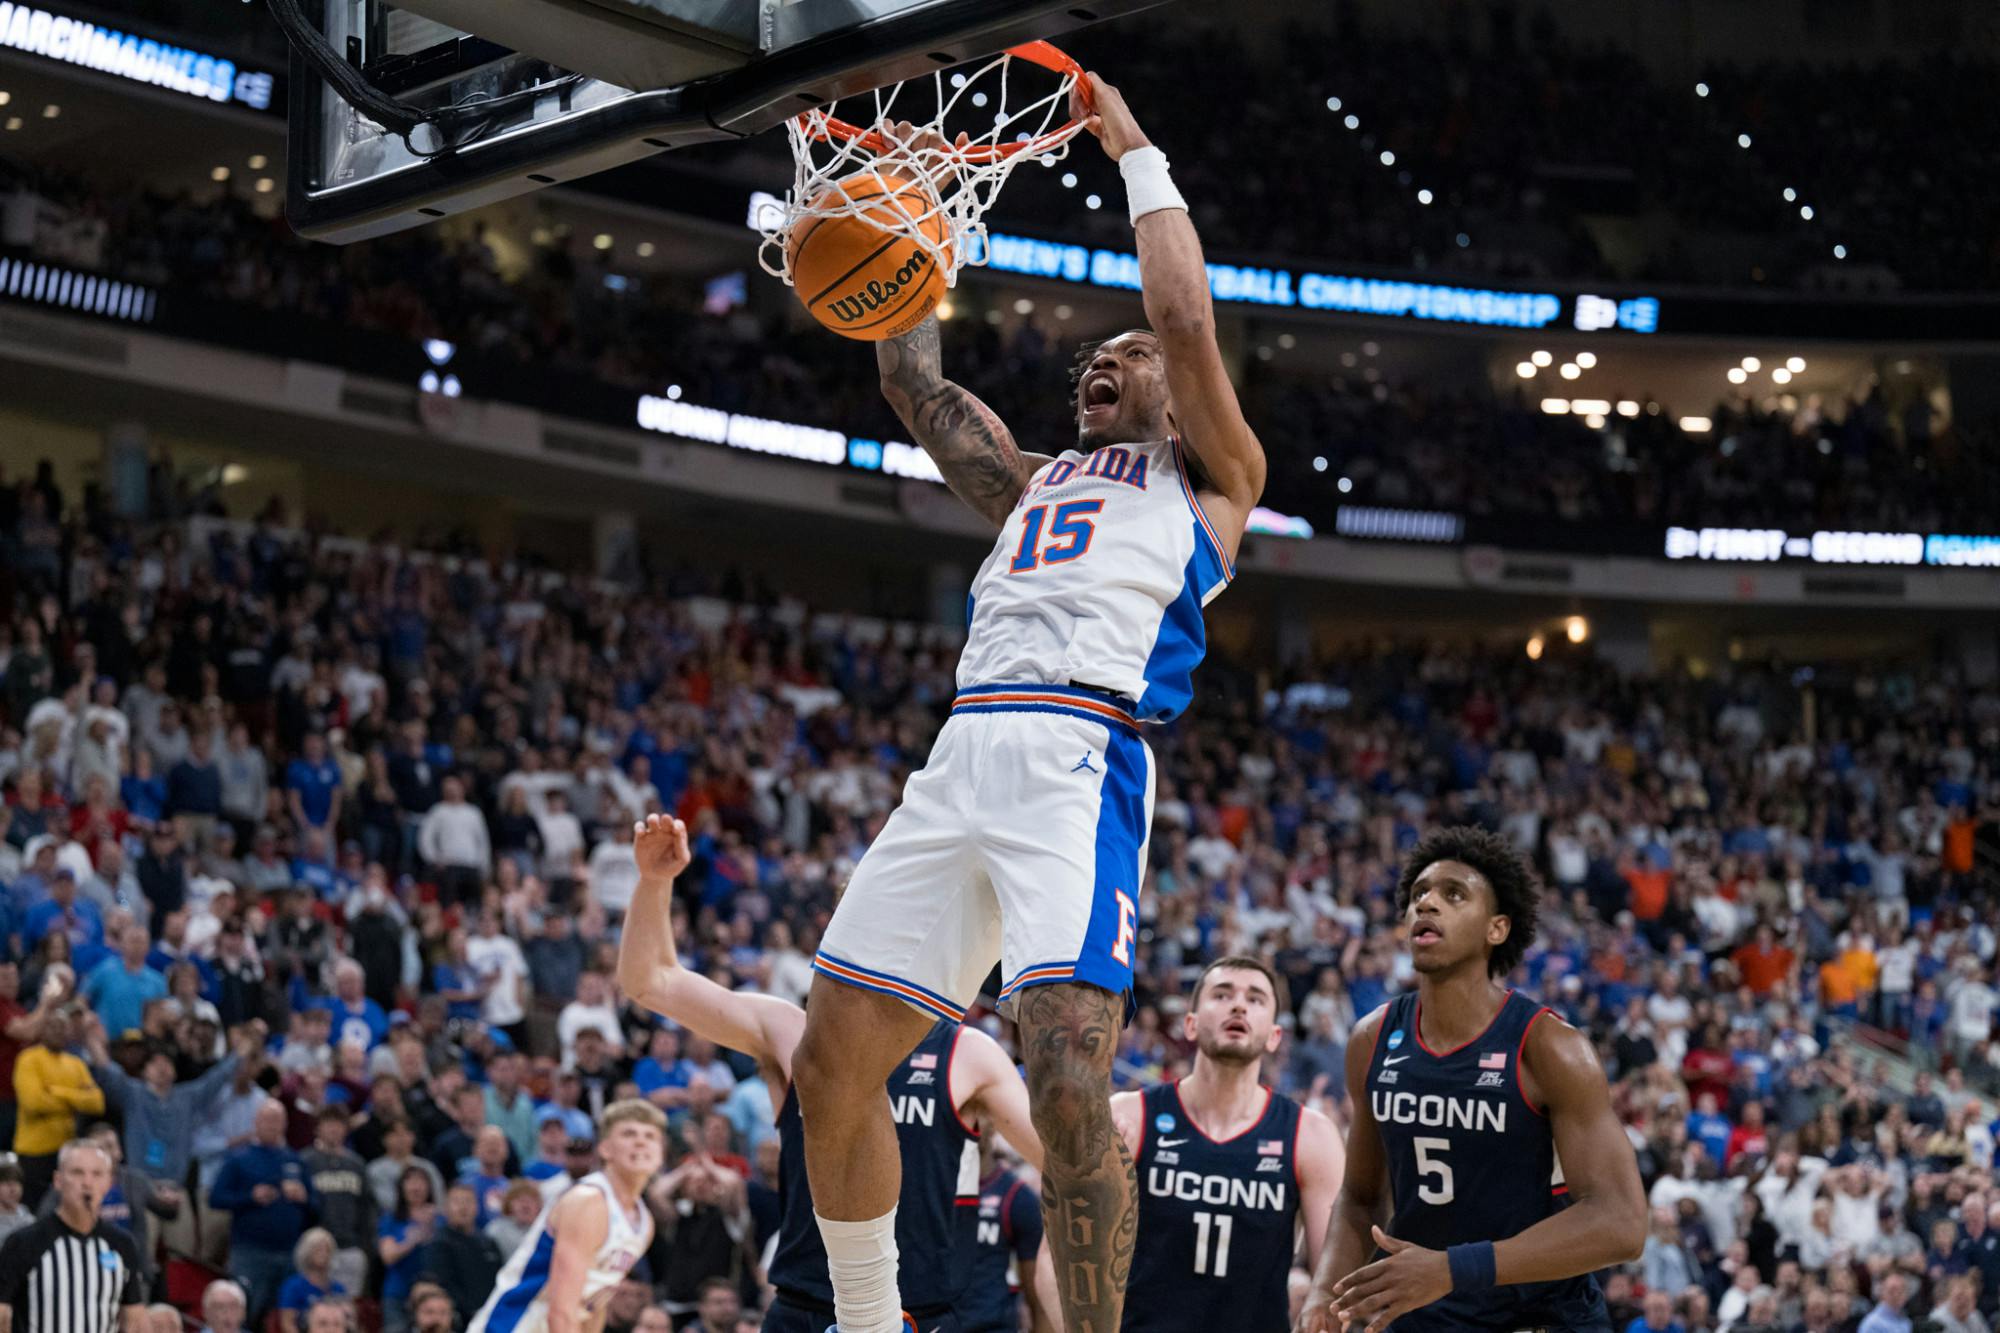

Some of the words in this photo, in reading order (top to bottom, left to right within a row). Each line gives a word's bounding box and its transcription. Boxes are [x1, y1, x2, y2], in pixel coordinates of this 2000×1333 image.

[827, 249, 929, 323] Wilson
[1009, 499, 1105, 574] 15
[1111, 887, 1136, 968] F
[1372, 1090, 1507, 1133] UCONN
[1148, 1166, 1286, 1211] UCONN
[1413, 1136, 1455, 1206] 5
[1193, 1211, 1233, 1278] 11
